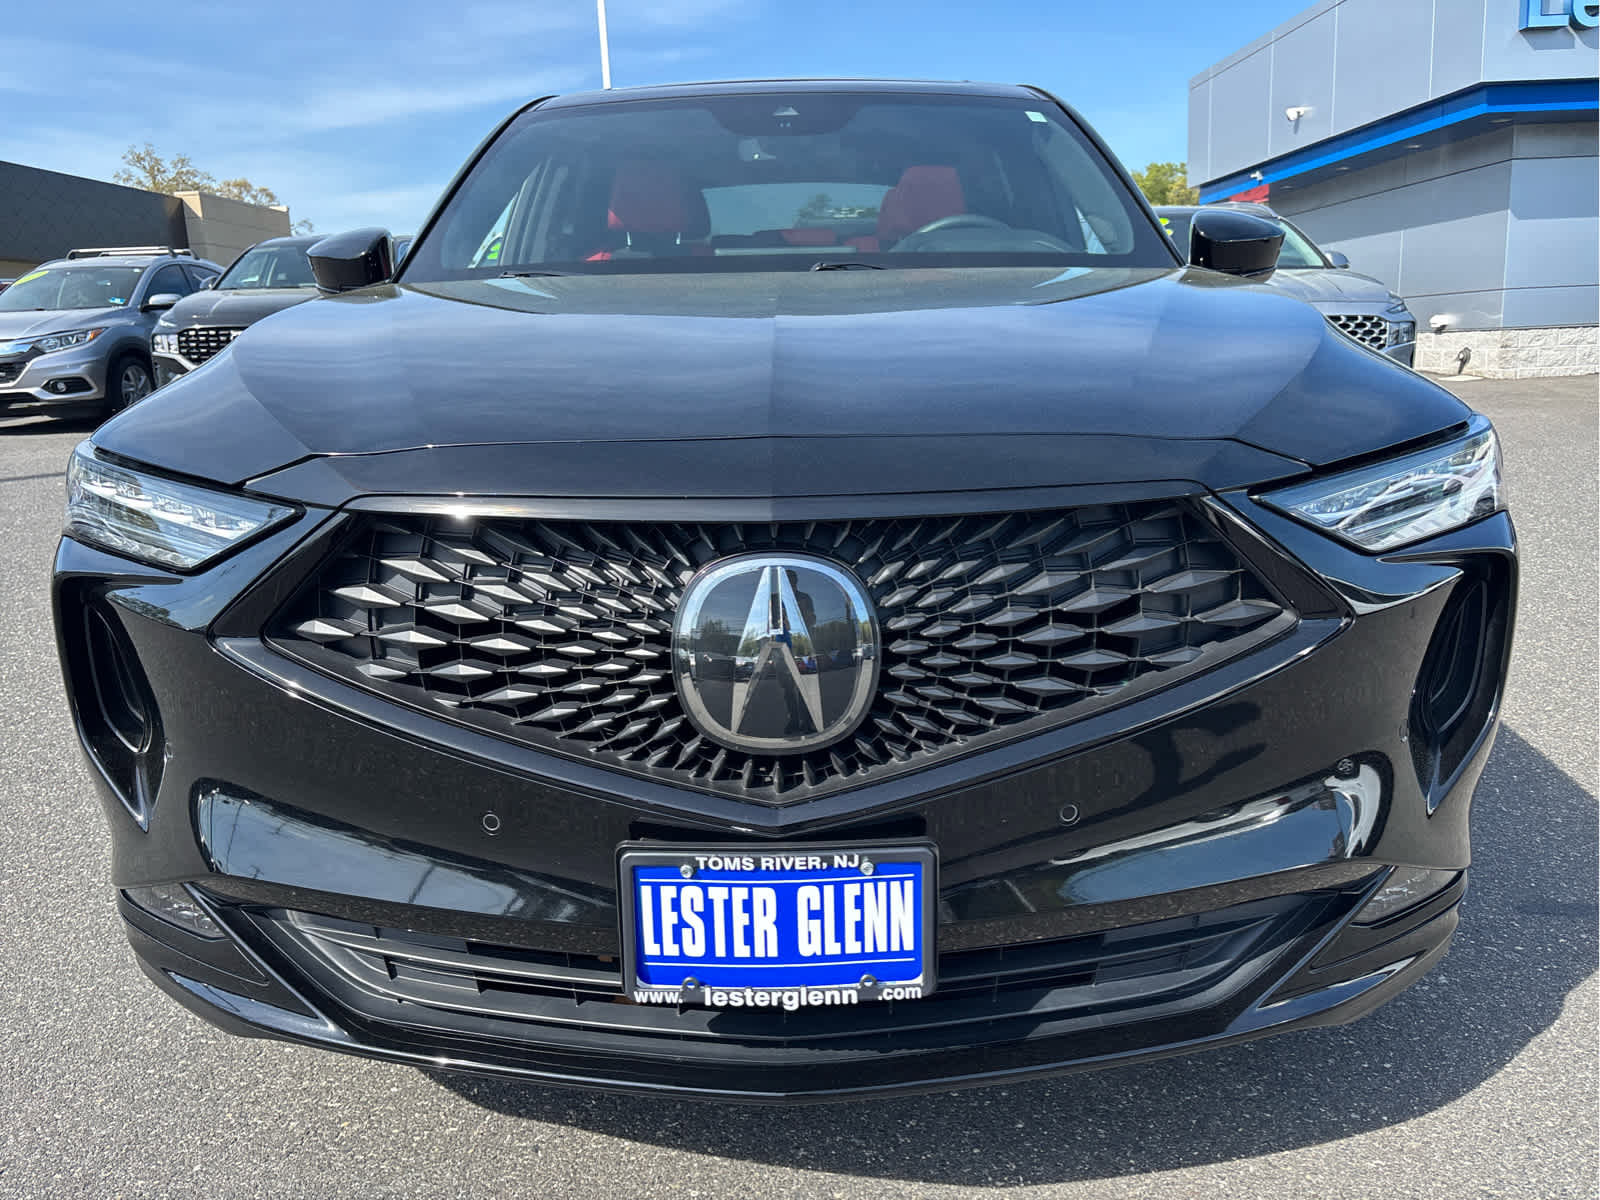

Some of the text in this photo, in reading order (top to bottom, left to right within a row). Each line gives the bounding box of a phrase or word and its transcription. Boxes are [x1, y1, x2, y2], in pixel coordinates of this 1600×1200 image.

[696, 855, 859, 871] TOMS RIVER, NJ
[640, 880, 914, 958] LESTER GLENN
[633, 986, 922, 1011] www. lesterglenn .com
